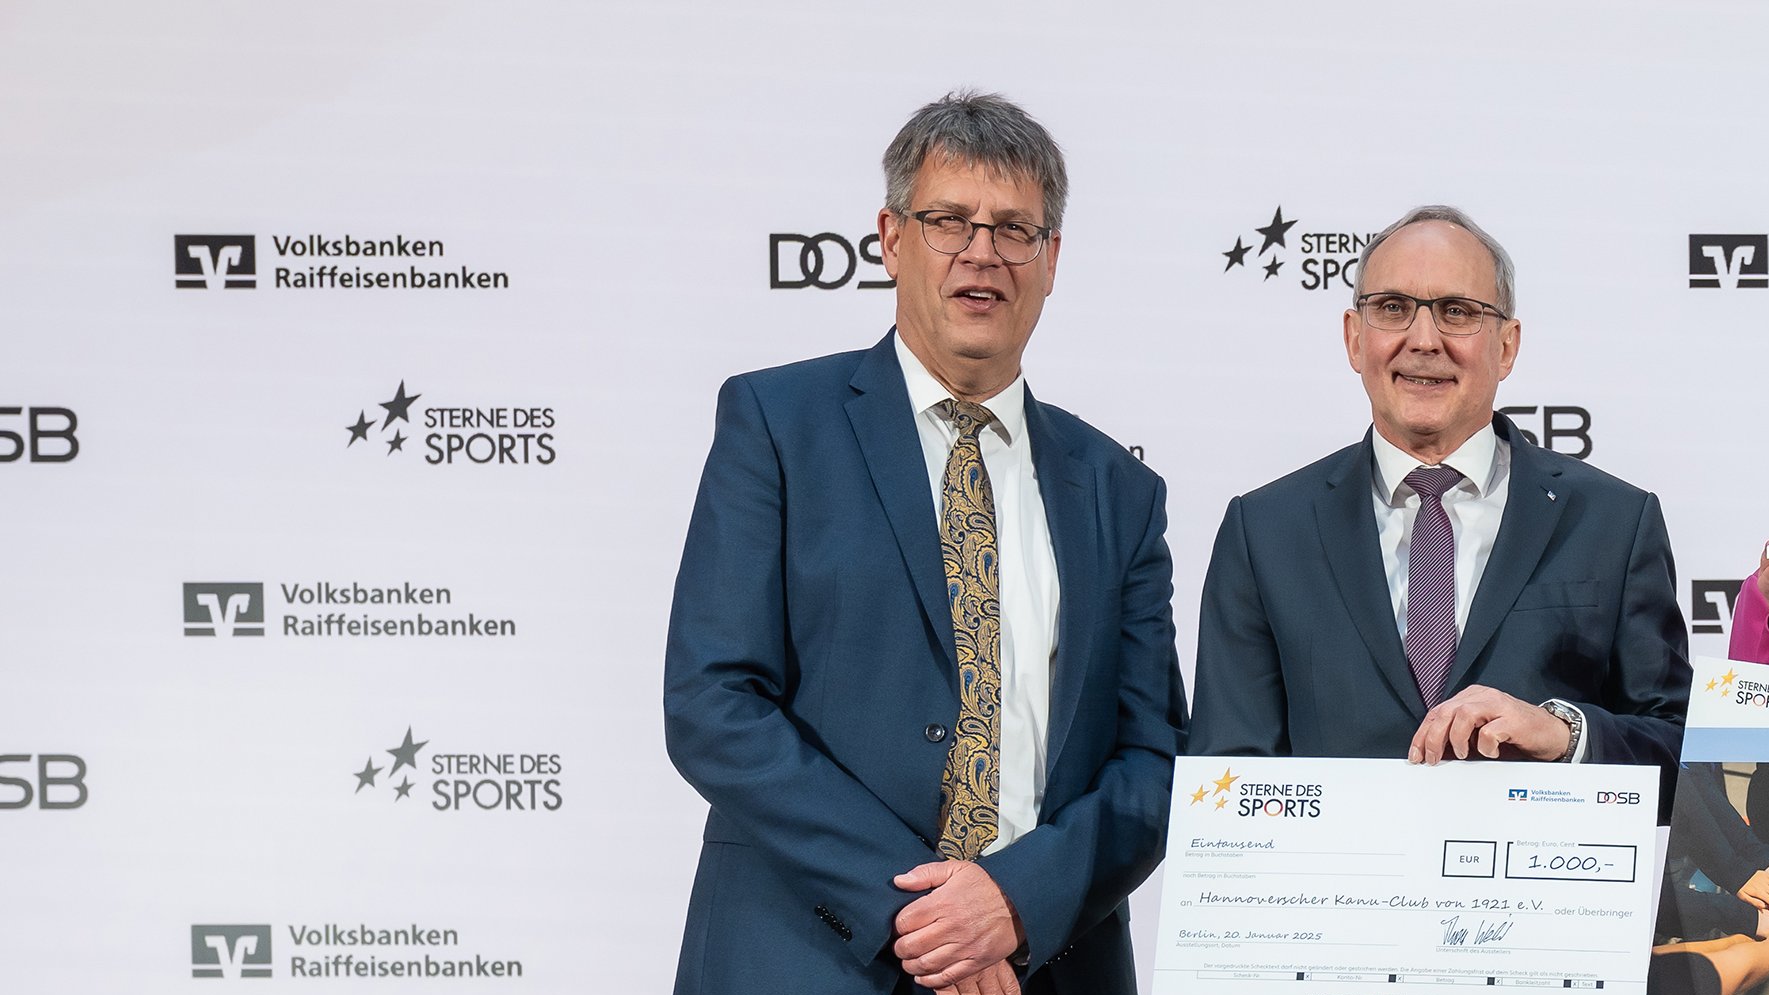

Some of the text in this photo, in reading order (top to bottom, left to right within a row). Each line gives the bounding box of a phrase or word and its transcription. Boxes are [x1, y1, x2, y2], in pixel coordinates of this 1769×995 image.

[273, 235, 443, 256] Volksbanken
[276, 266, 508, 288] Raiffeisenbanken
[425, 408, 555, 428] STERNE DES
[425, 433, 555, 464] SPORTS
[281, 582, 450, 604] Volksbanken
[284, 614, 515, 635] Raiffeisenbanken
[432, 754, 561, 774] STERNE DES
[433, 779, 562, 811] SPORTS
[1240, 783, 1322, 797] STERNE DES
[1597, 791, 1641, 805] DOSB
[1238, 798, 1321, 818] SPORTS
[1191, 838, 1275, 849] Eintausend
[1459, 855, 1480, 863] EUR
[1199, 892, 1329, 905] Hannoverscher
[1334, 894, 1428, 909] Kanu-Club
[1436, 901, 1465, 909] von
[1471, 898, 1510, 910] 1921
[1518, 899, 1544, 911] e.V.
[1554, 907, 1575, 916] oder
[1578, 906, 1633, 918] Überbringer
[289, 924, 457, 945] Volksbanken
[1179, 929, 1323, 941] Berlin, 20. Januar 2025
[292, 955, 522, 977] Raiffeisenbanken
